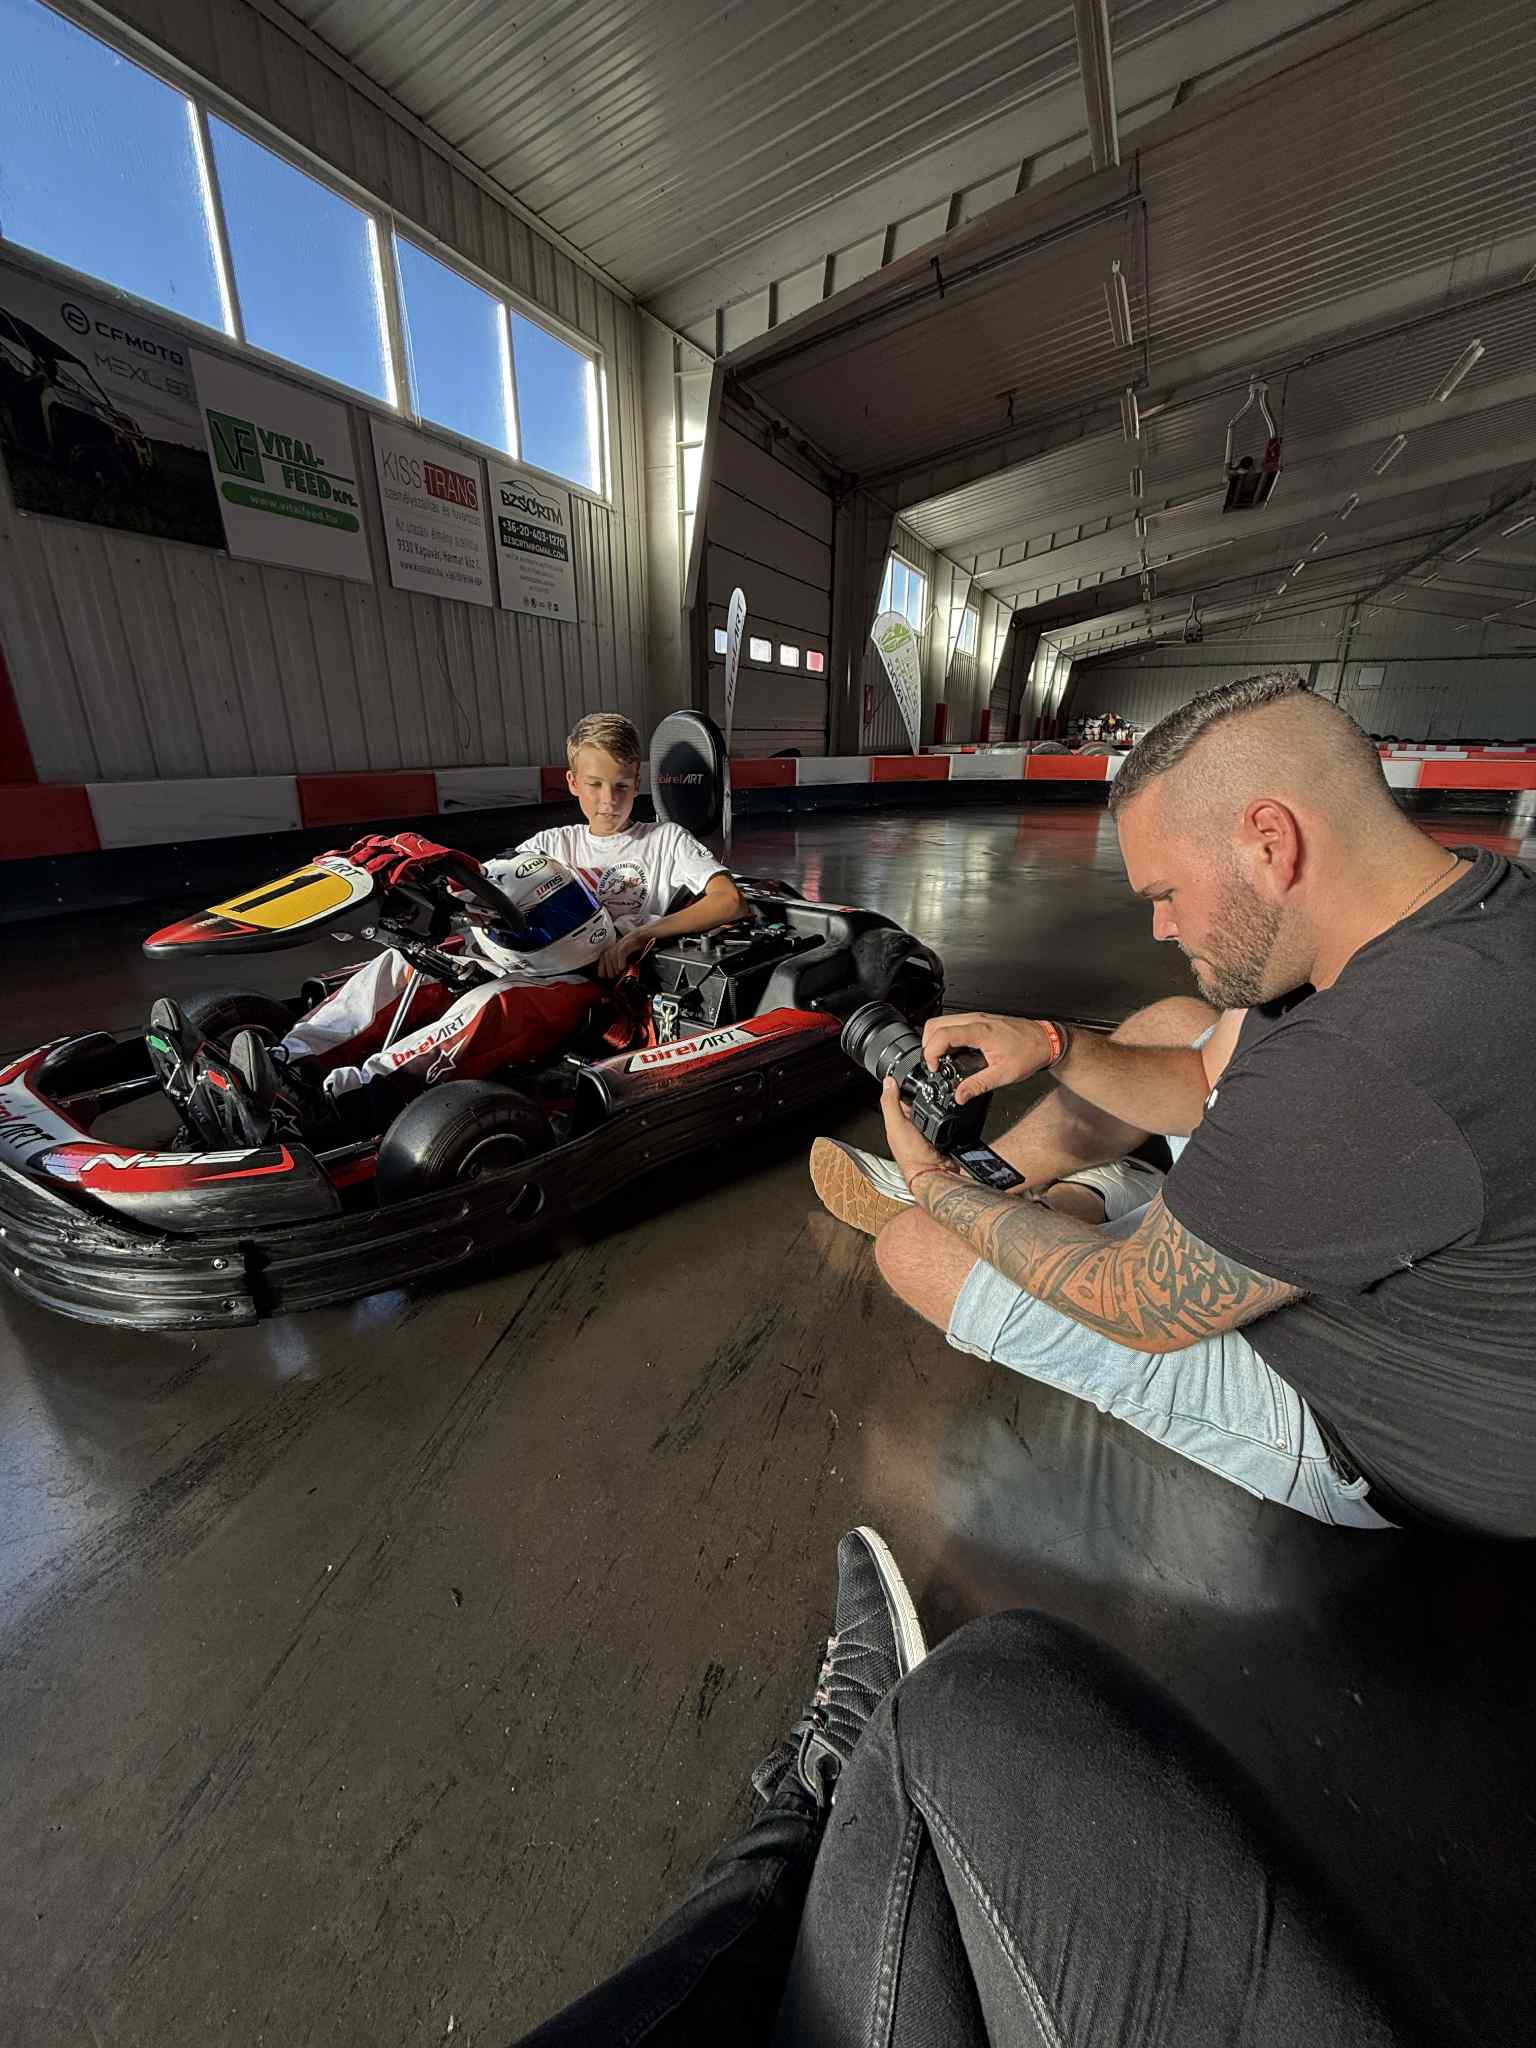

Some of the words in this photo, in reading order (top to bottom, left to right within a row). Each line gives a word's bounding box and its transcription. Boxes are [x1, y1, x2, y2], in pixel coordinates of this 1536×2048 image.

[95, 321, 183, 366] CFMOTO
[281, 464, 332, 499] FEED
[382, 447, 422, 489] KISS
[229, 872, 332, 913] 1
[640, 1030, 735, 1064] birelART
